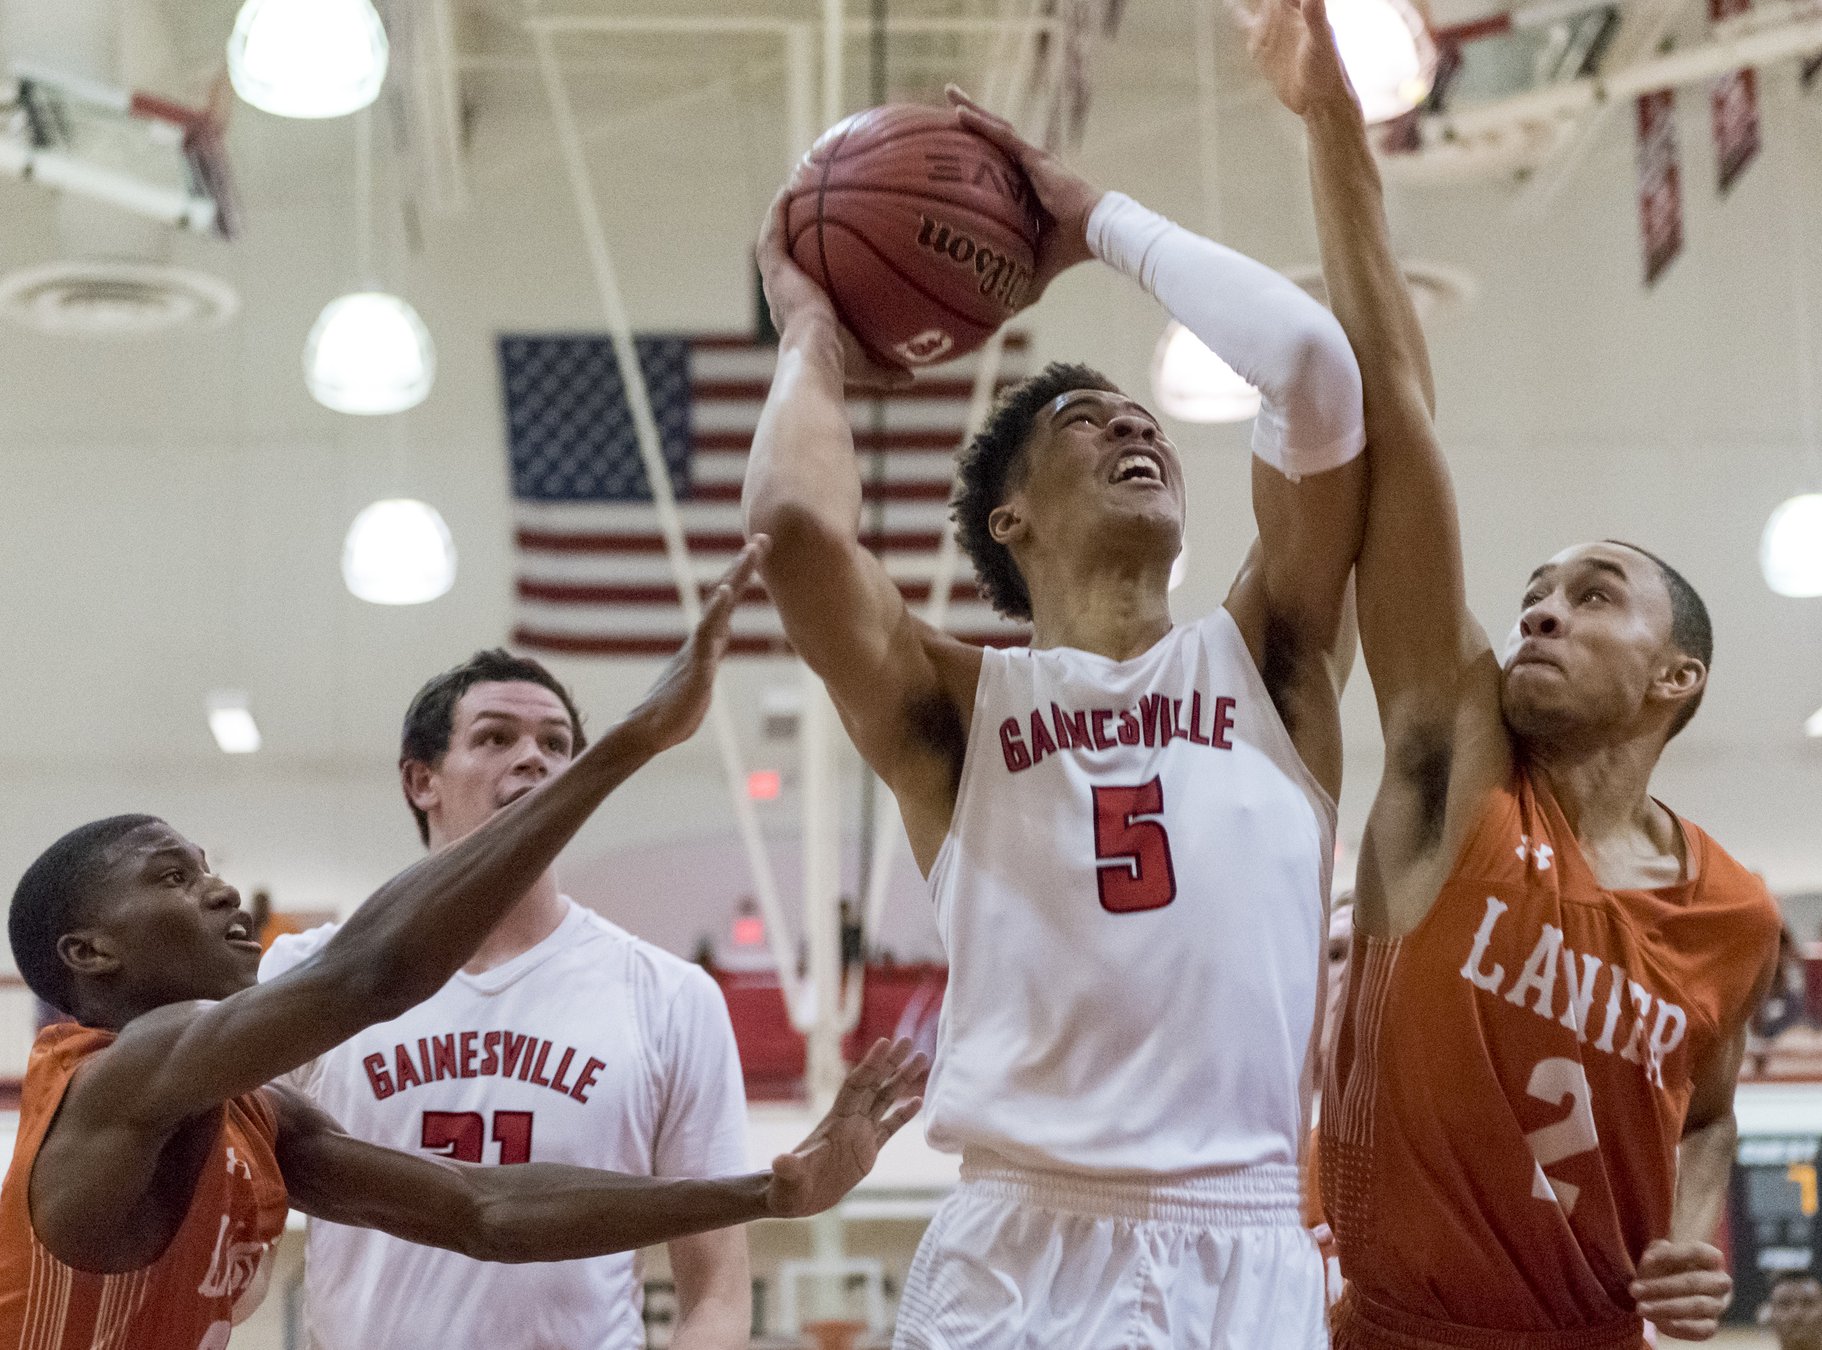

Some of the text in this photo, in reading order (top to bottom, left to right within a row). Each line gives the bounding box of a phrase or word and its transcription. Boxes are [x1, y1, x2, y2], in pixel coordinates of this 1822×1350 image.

[999, 689, 1236, 773] GAINESVILLE
[1091, 774, 1176, 915] 5
[1460, 896, 1687, 1090] LANIER
[363, 1030, 607, 1104] GAINESVILLE
[1526, 1056, 1600, 1217] 2
